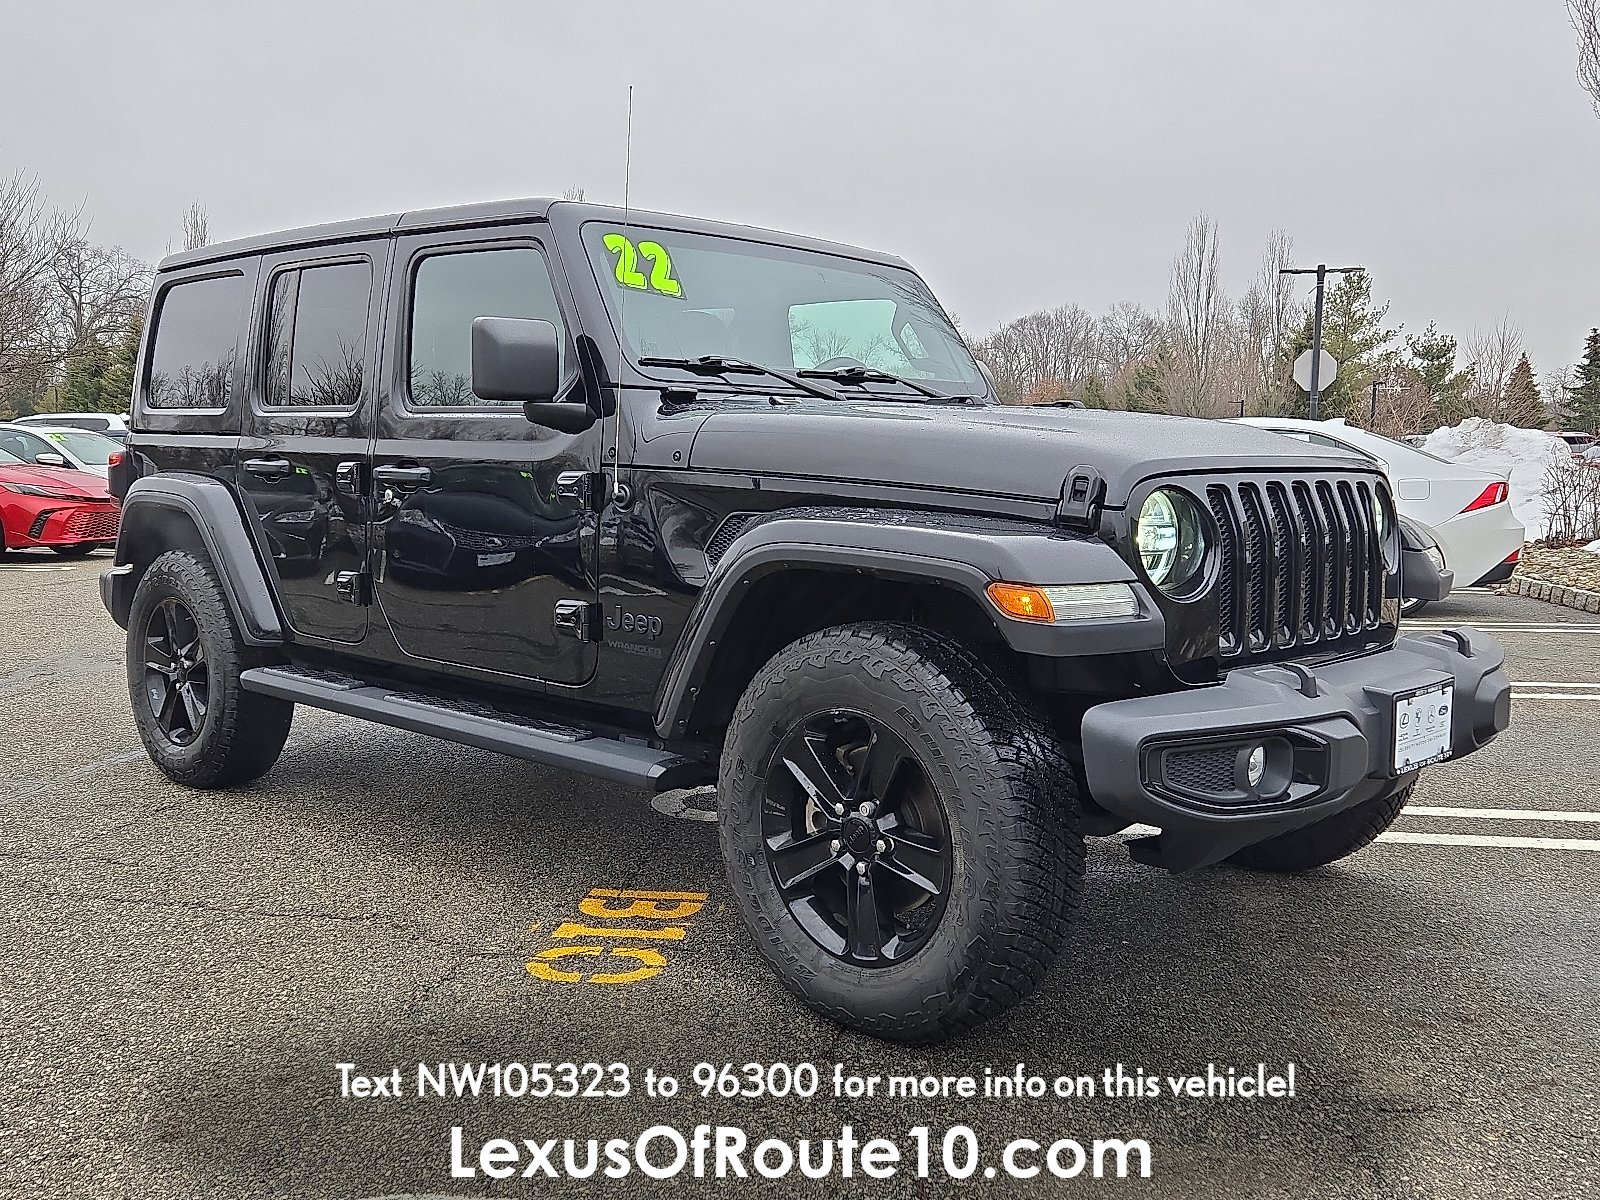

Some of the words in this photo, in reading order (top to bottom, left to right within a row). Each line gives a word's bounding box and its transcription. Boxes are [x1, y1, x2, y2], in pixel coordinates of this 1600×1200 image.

[602, 233, 682, 297] 22
[606, 604, 663, 641] Jeep
[607, 639, 663, 656] WRANGLER
